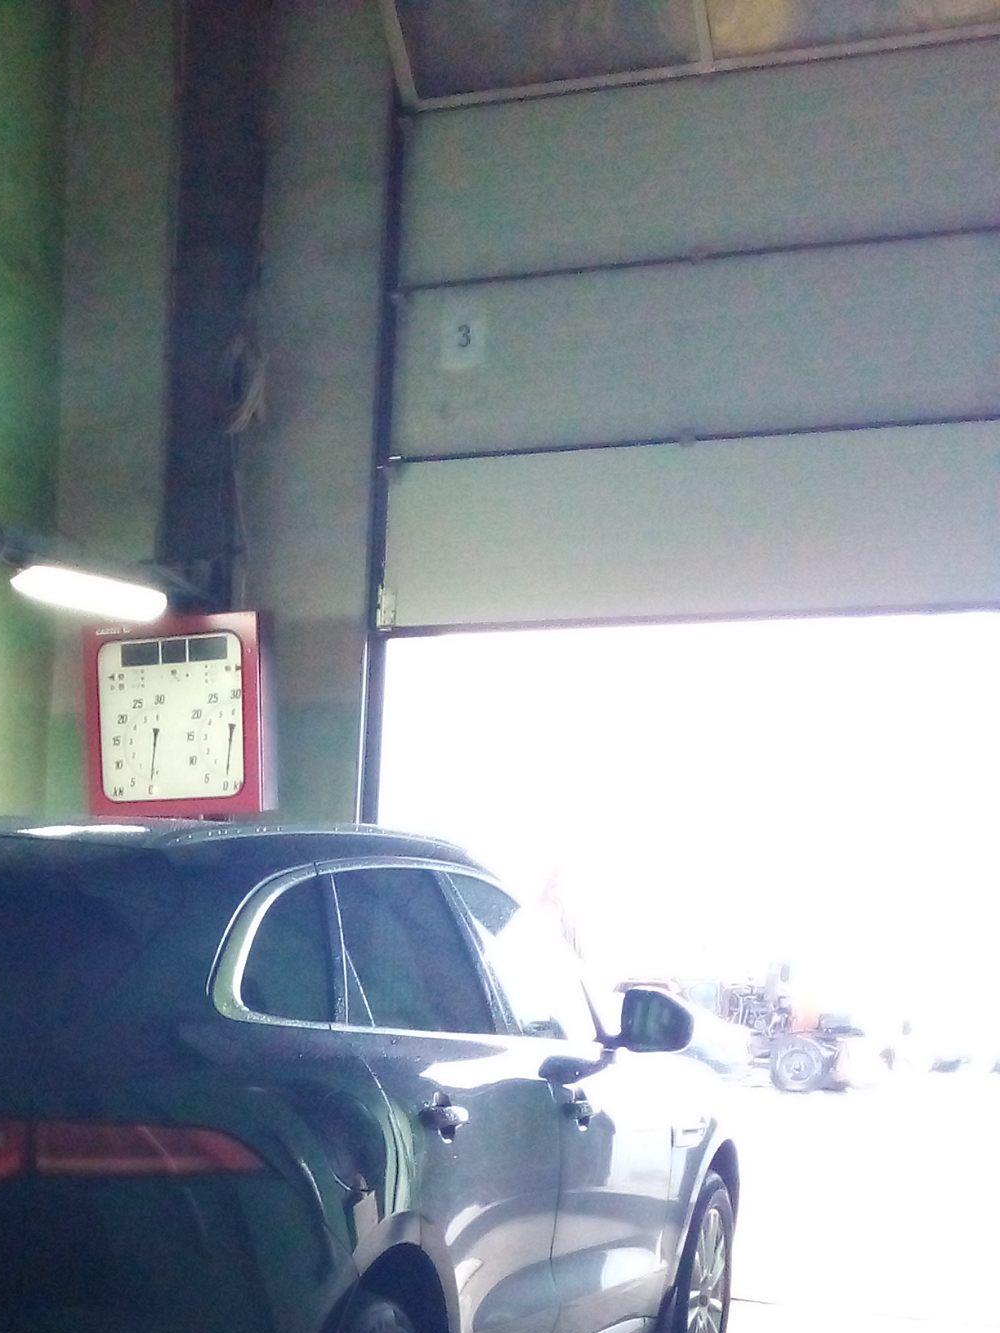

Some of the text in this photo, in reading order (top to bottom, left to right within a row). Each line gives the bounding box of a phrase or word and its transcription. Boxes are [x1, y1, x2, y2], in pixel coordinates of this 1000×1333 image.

[458, 324, 471, 348] 3
[154, 694, 165, 705] 30
[208, 693, 219, 704] 25
[230, 689, 241, 700] 30
[132, 698, 143, 709] 25
[117, 713, 128, 725] 20
[191, 709, 202, 720] 20
[112, 735, 121, 746] 15
[187, 731, 195, 742] 15
[115, 760, 124, 770] 10
[189, 755, 198, 766] 10
[130, 777, 136, 787] 5
[204, 773, 210, 784] 5
[223, 780, 229, 791] 0
